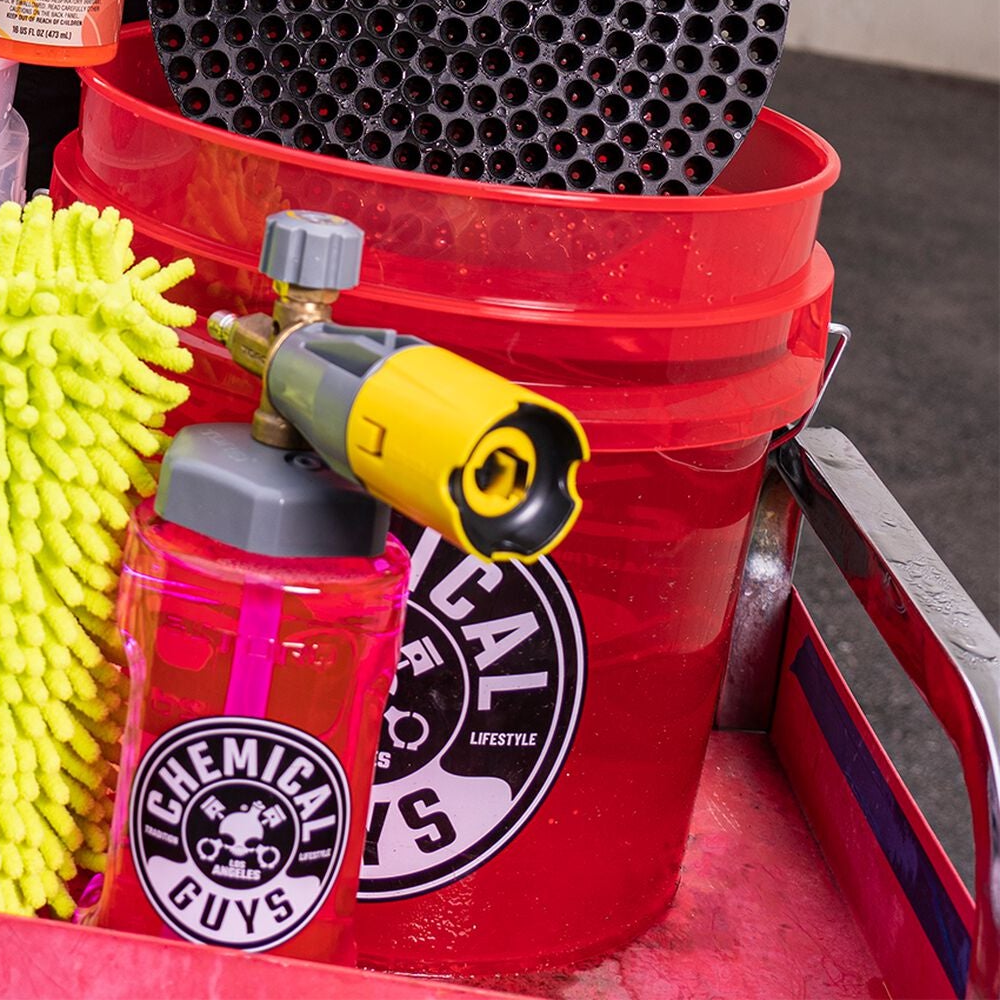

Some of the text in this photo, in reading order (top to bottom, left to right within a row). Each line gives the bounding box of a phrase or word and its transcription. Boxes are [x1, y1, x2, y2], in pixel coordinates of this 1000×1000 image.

[36, 16, 52, 24] REACH
[20, 26, 28, 34] US
[29, 28, 36, 36] FL
[36, 29, 45, 37] OZ
[470, 730, 538, 747] LIFESTYLE
[146, 736, 336, 843] CHEMICAL
[229, 858, 246, 869] LOS
[211, 864, 262, 881] ANGELES
[168, 875, 294, 935] GUYS
